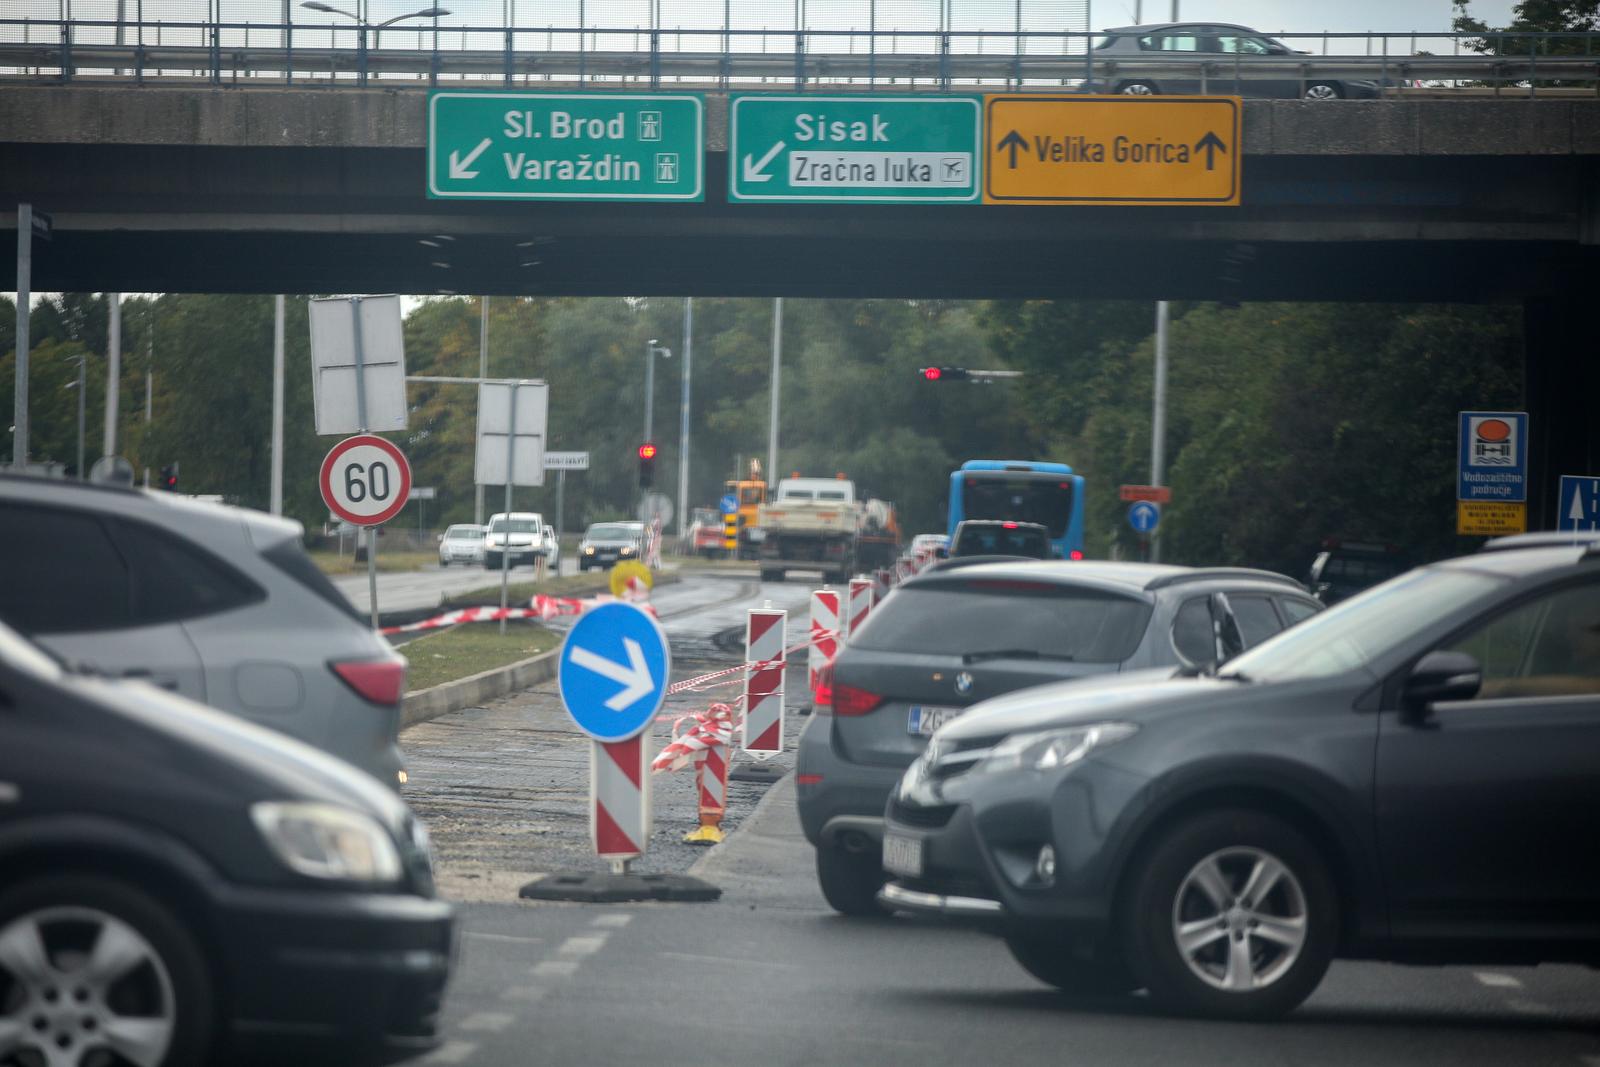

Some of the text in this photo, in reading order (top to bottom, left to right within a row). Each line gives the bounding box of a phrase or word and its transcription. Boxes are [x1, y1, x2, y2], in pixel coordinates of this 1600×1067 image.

[503, 110, 625, 139] Sl. Brod
[794, 113, 890, 141] Sisak
[1034, 134, 1190, 164] Velika Gorica
[503, 152, 641, 181] Varaždin
[794, 157, 932, 182] Zračna luka
[344, 461, 390, 503] 60
